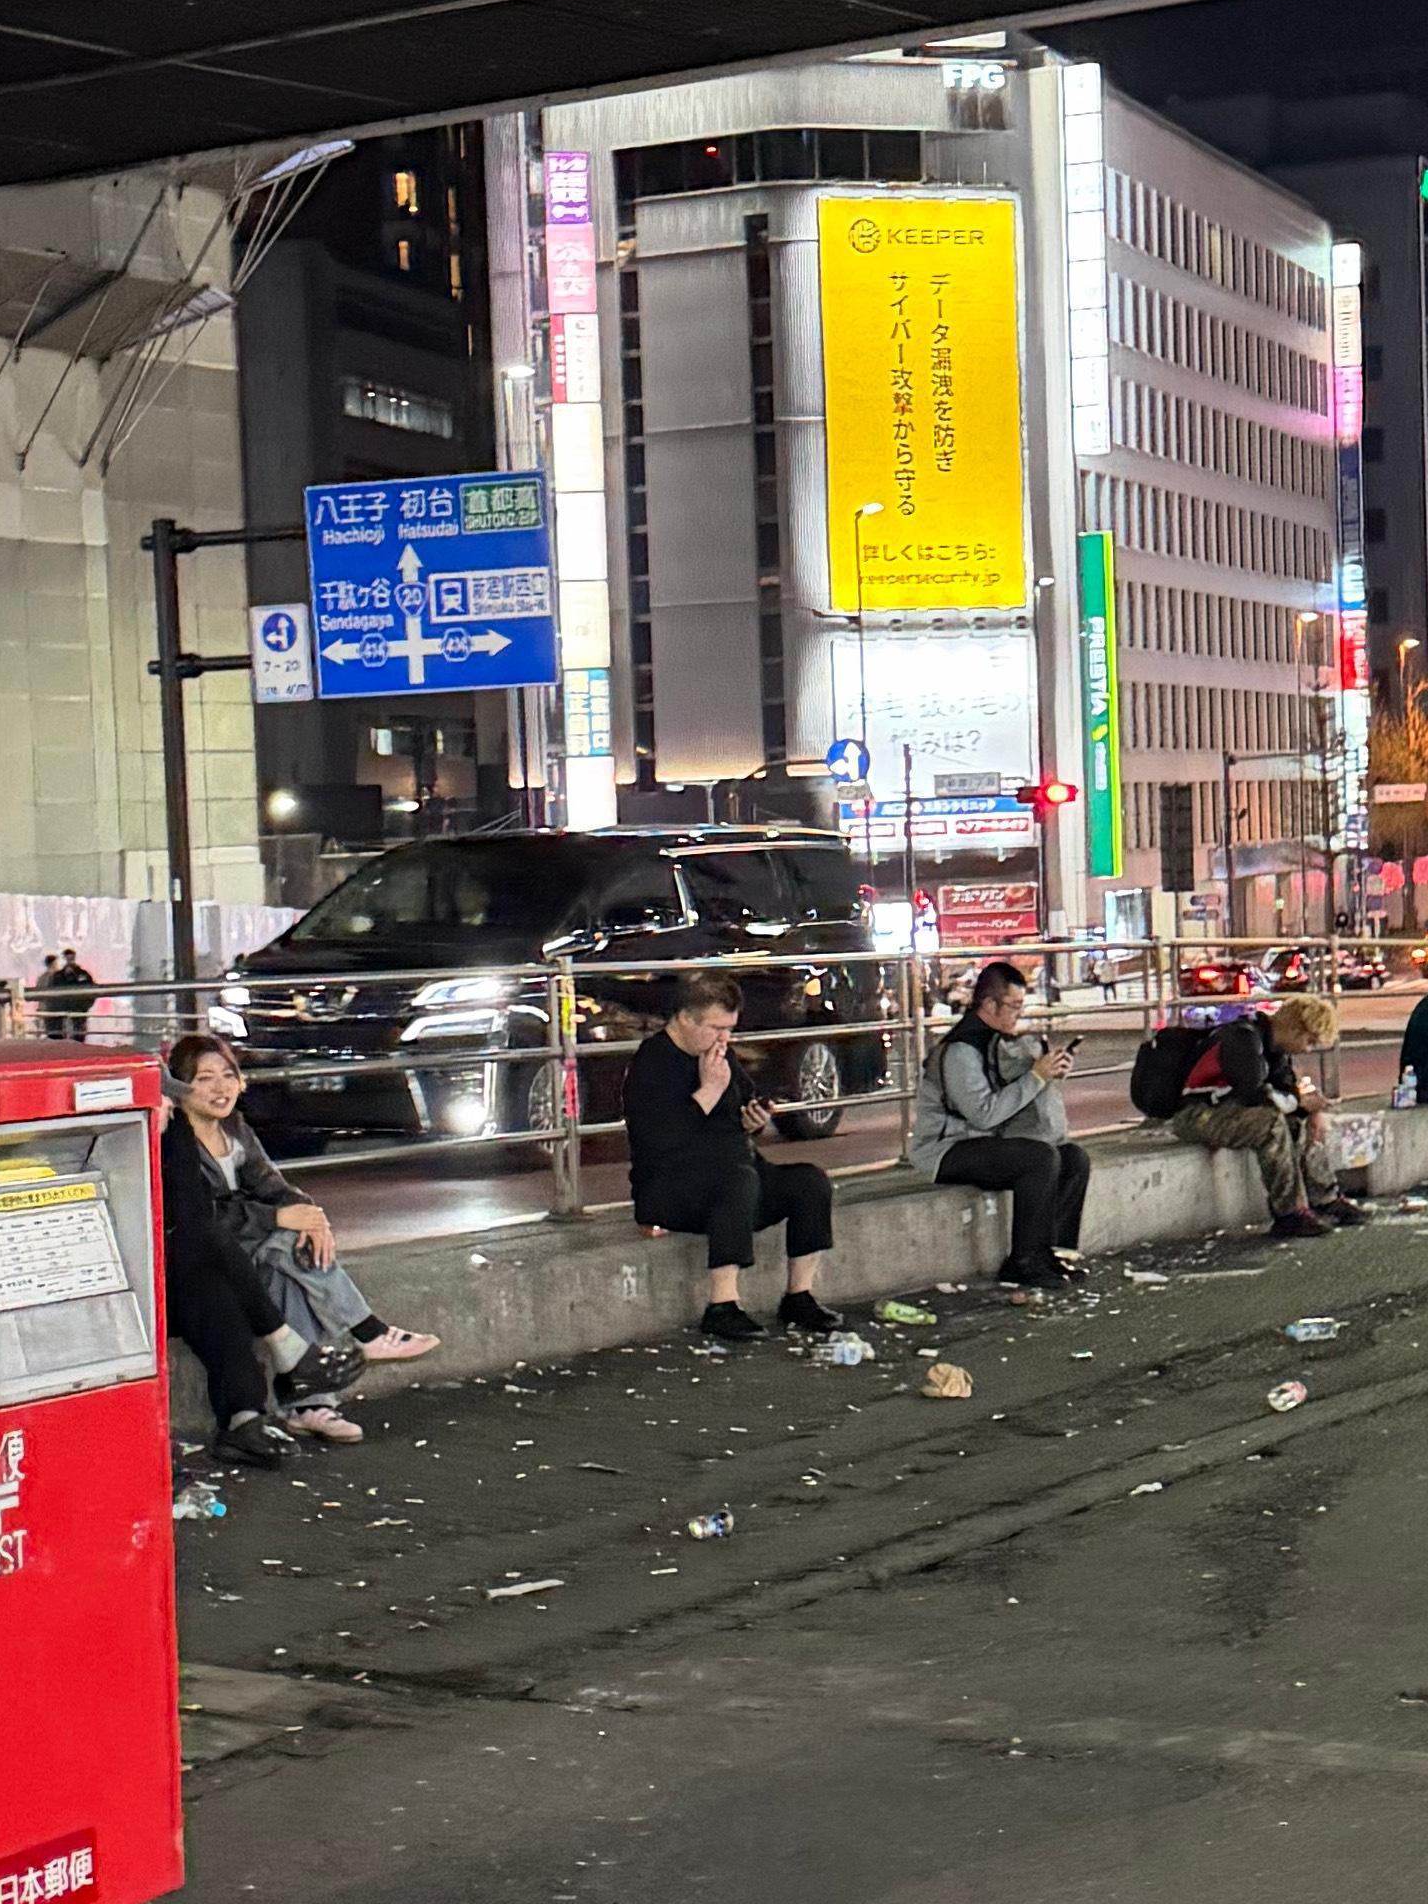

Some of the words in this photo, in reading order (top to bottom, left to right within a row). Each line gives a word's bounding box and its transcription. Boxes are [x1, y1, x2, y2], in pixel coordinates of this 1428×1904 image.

[887, 228, 985, 245] KEEPER
[930, 272, 956, 473] データ漏洩を防ぎ
[889, 271, 916, 516] サイバー攻撃から守る
[314, 491, 390, 526] 八王子
[399, 487, 454, 520] 初台
[322, 527, 386, 546] Hachioji
[402, 586, 422, 606] 20
